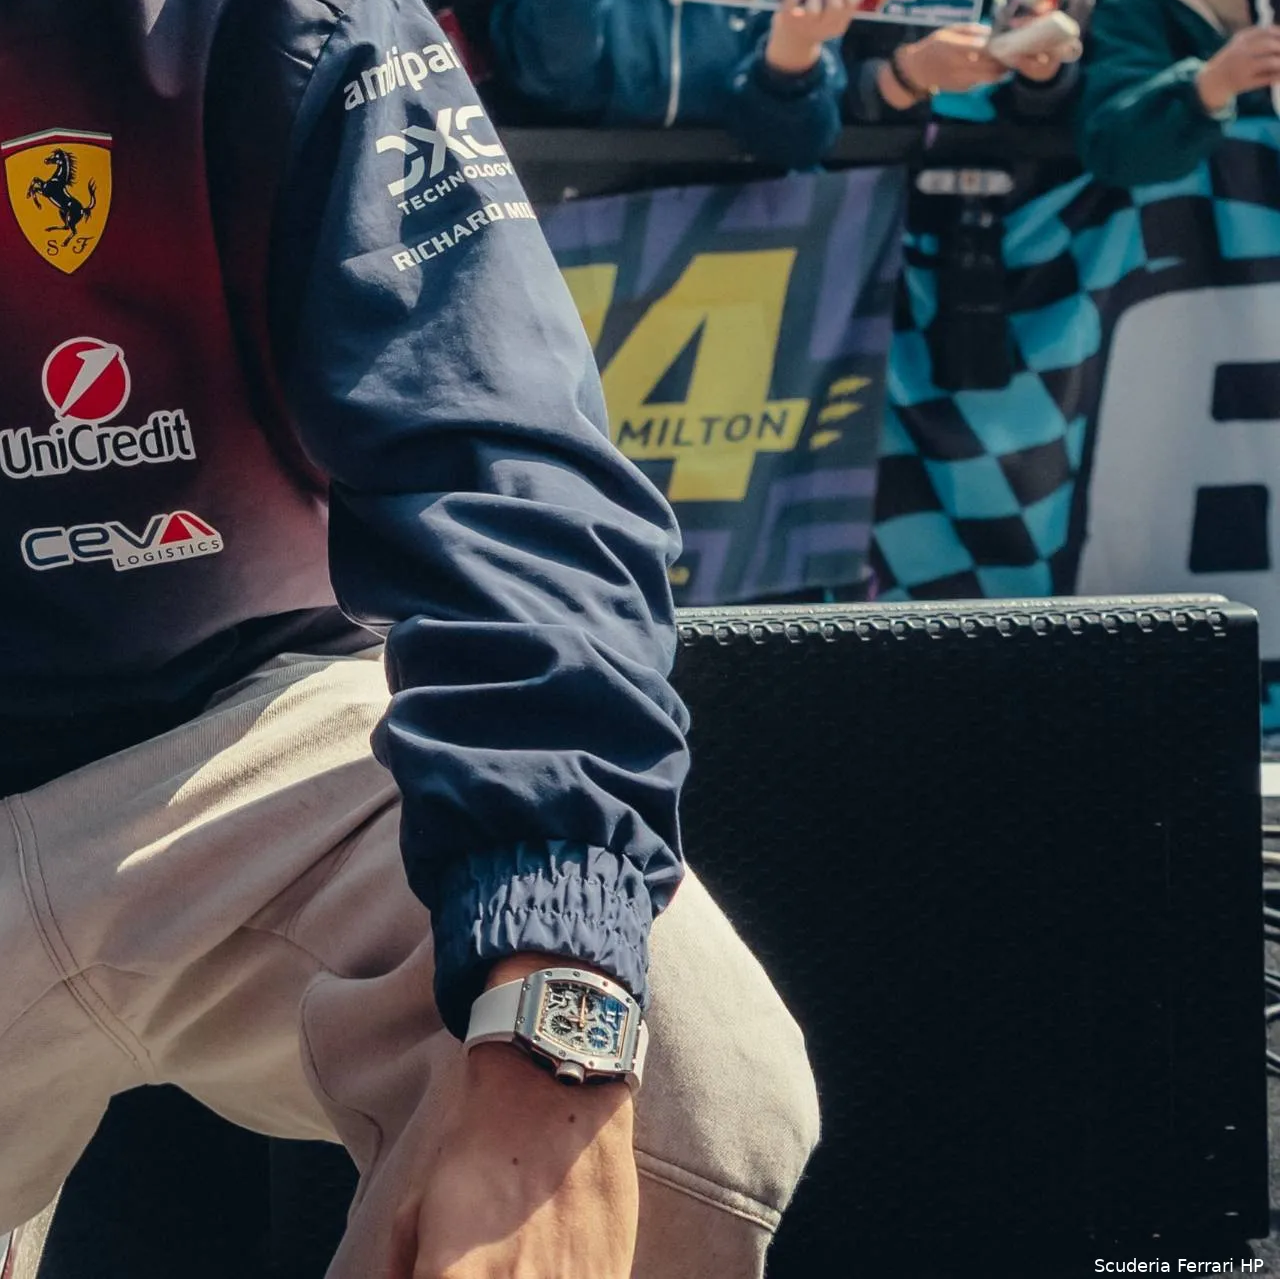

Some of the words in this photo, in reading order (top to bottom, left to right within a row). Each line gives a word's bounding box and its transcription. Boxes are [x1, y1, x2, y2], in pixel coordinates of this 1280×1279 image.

[375, 104, 505, 198] DXC
[396, 162, 514, 217] TECHNOLOGY
[391, 202, 505, 272] RICHARD
[503, 201, 538, 221] MIL
[0, 413, 192, 475] UniCredit
[616, 409, 789, 449] MILTON
[115, 538, 221, 569] LOGISTICS
